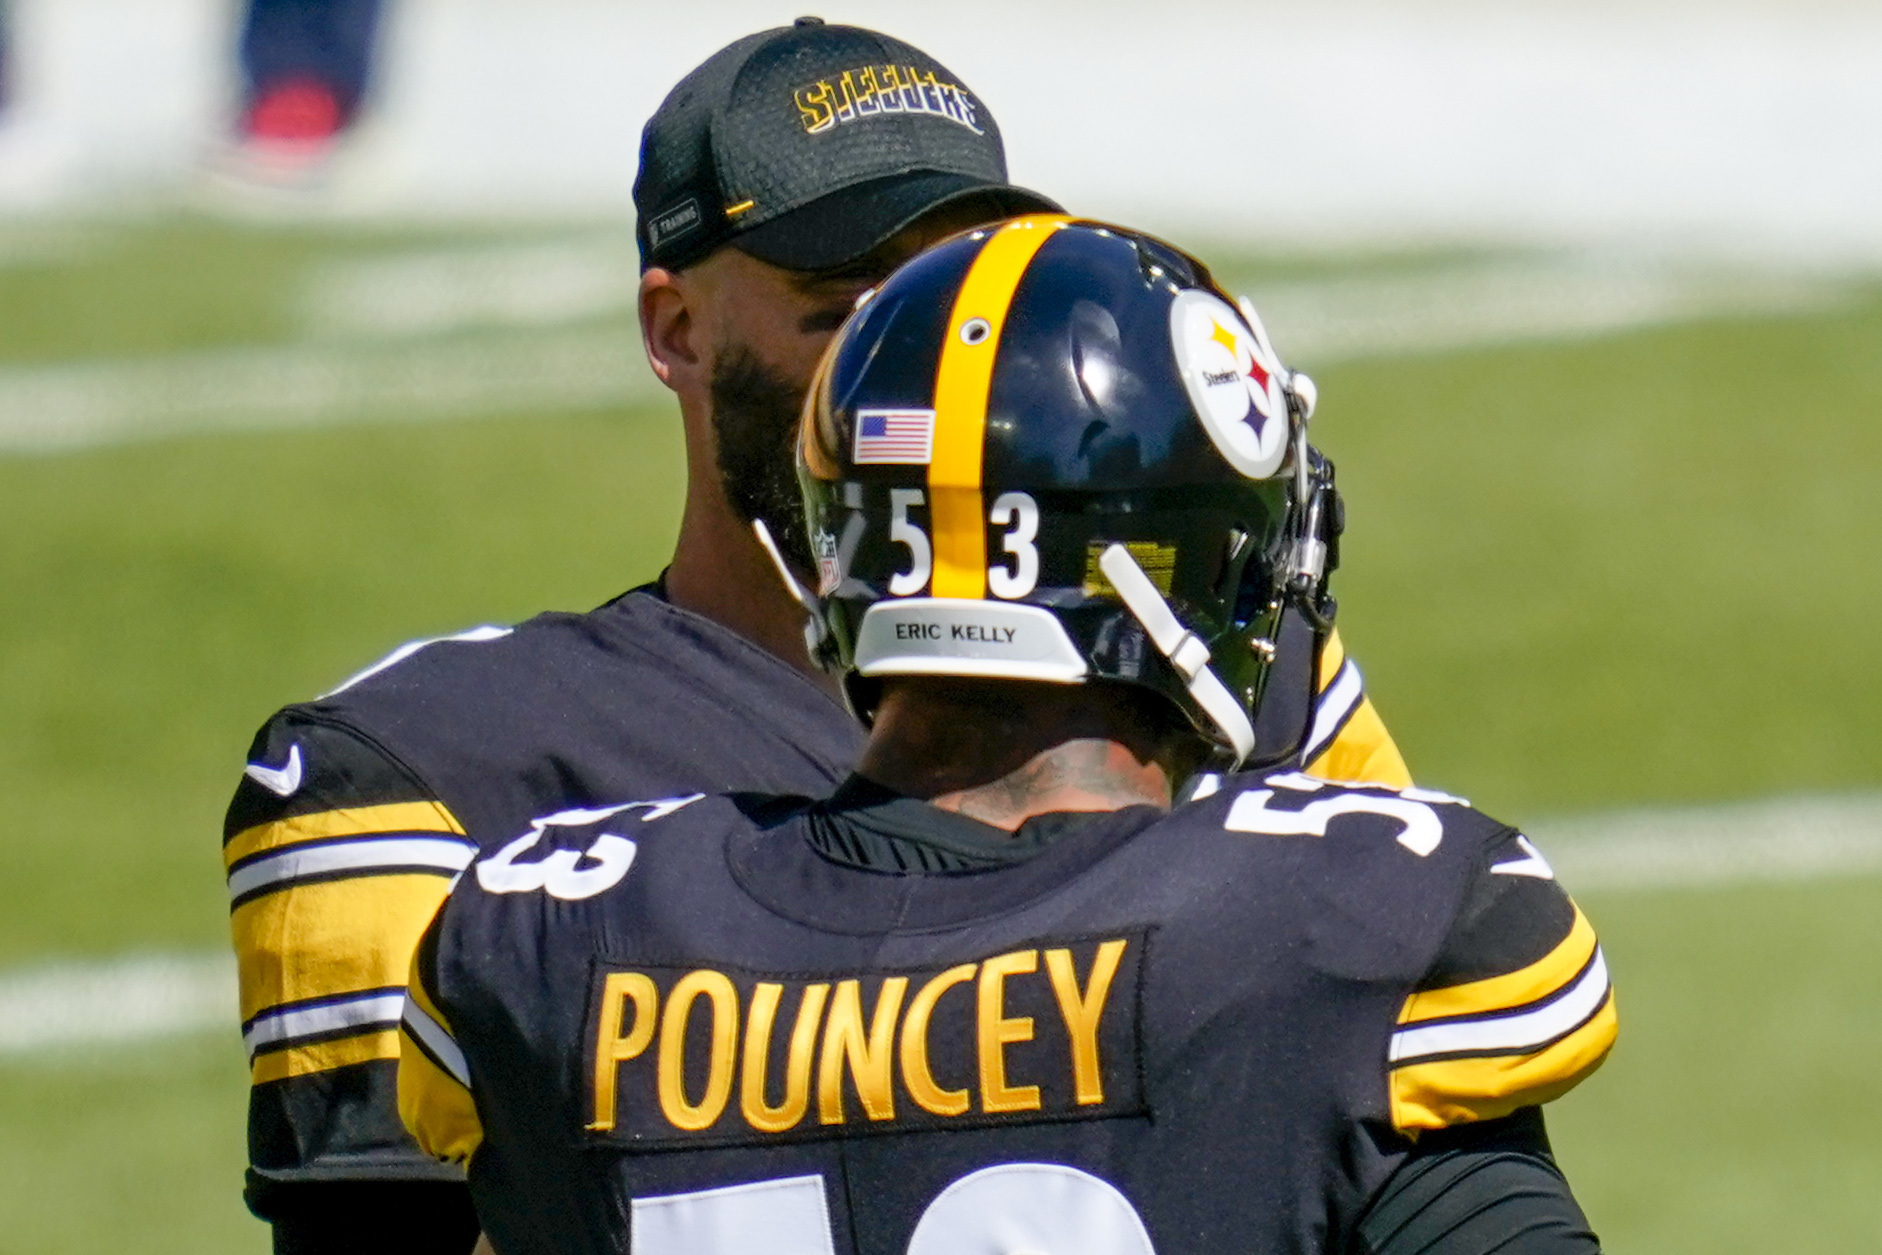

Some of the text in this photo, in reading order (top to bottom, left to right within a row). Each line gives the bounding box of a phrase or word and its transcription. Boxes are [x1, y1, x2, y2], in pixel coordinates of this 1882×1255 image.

[895, 623, 1016, 643] ERIC KELLY
[584, 939, 1128, 1134] POUNCEY
